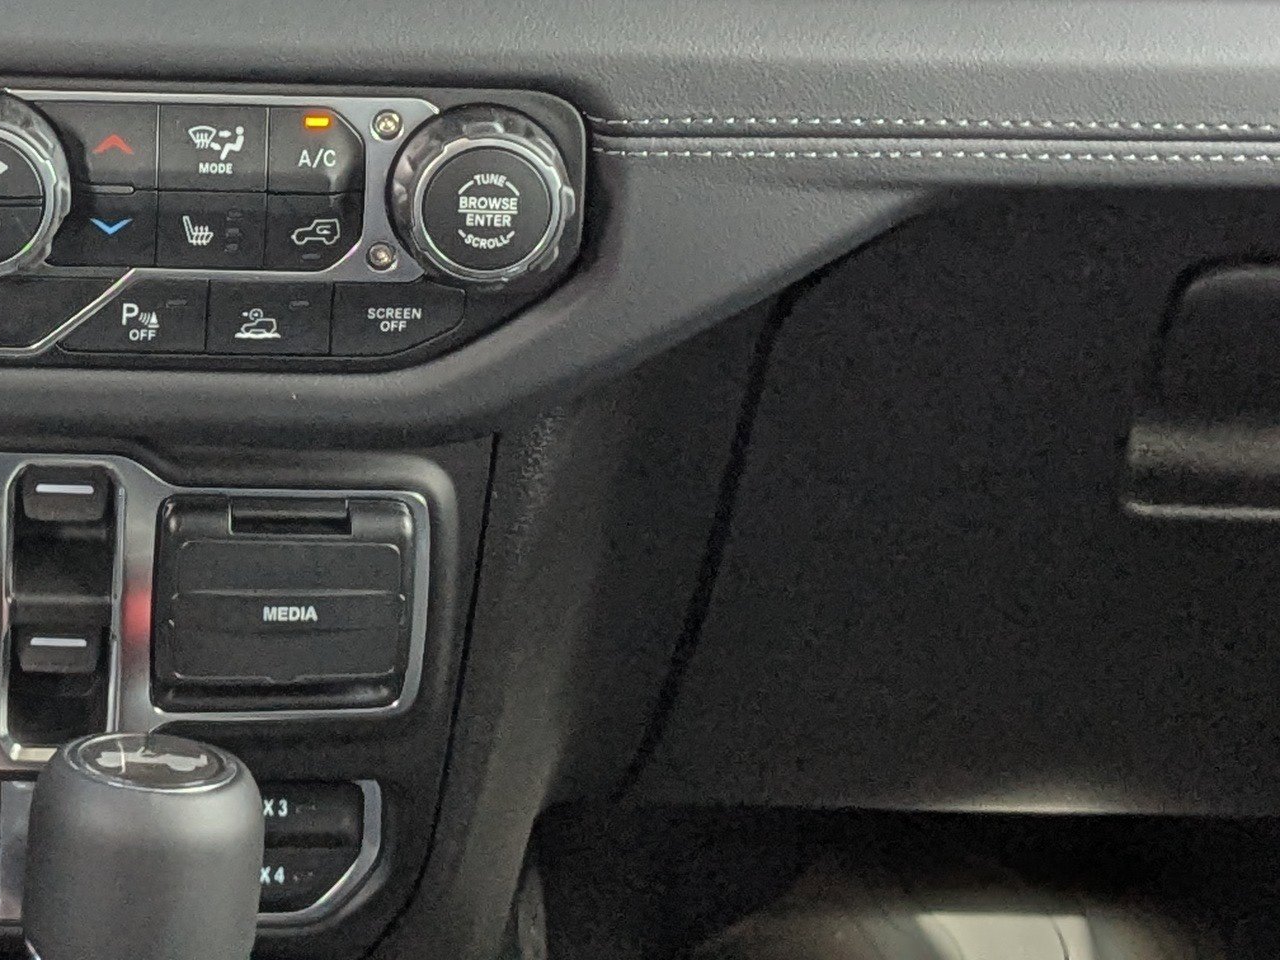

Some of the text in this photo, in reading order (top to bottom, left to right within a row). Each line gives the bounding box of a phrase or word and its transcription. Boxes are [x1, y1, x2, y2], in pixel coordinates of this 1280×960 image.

[298, 148, 337, 169] A/C
[198, 162, 233, 175] MODE
[475, 174, 506, 188] TUNE
[459, 195, 519, 212] BROWSE
[465, 211, 512, 227] ENTER
[465, 230, 513, 250] SCROLL
[367, 307, 422, 320] SCREEN
[380, 318, 406, 332] OFF
[129, 326, 156, 341] OFF
[263, 604, 318, 622] MEDIA
[278, 800, 288, 817] 3
[274, 866, 285, 883] 4
